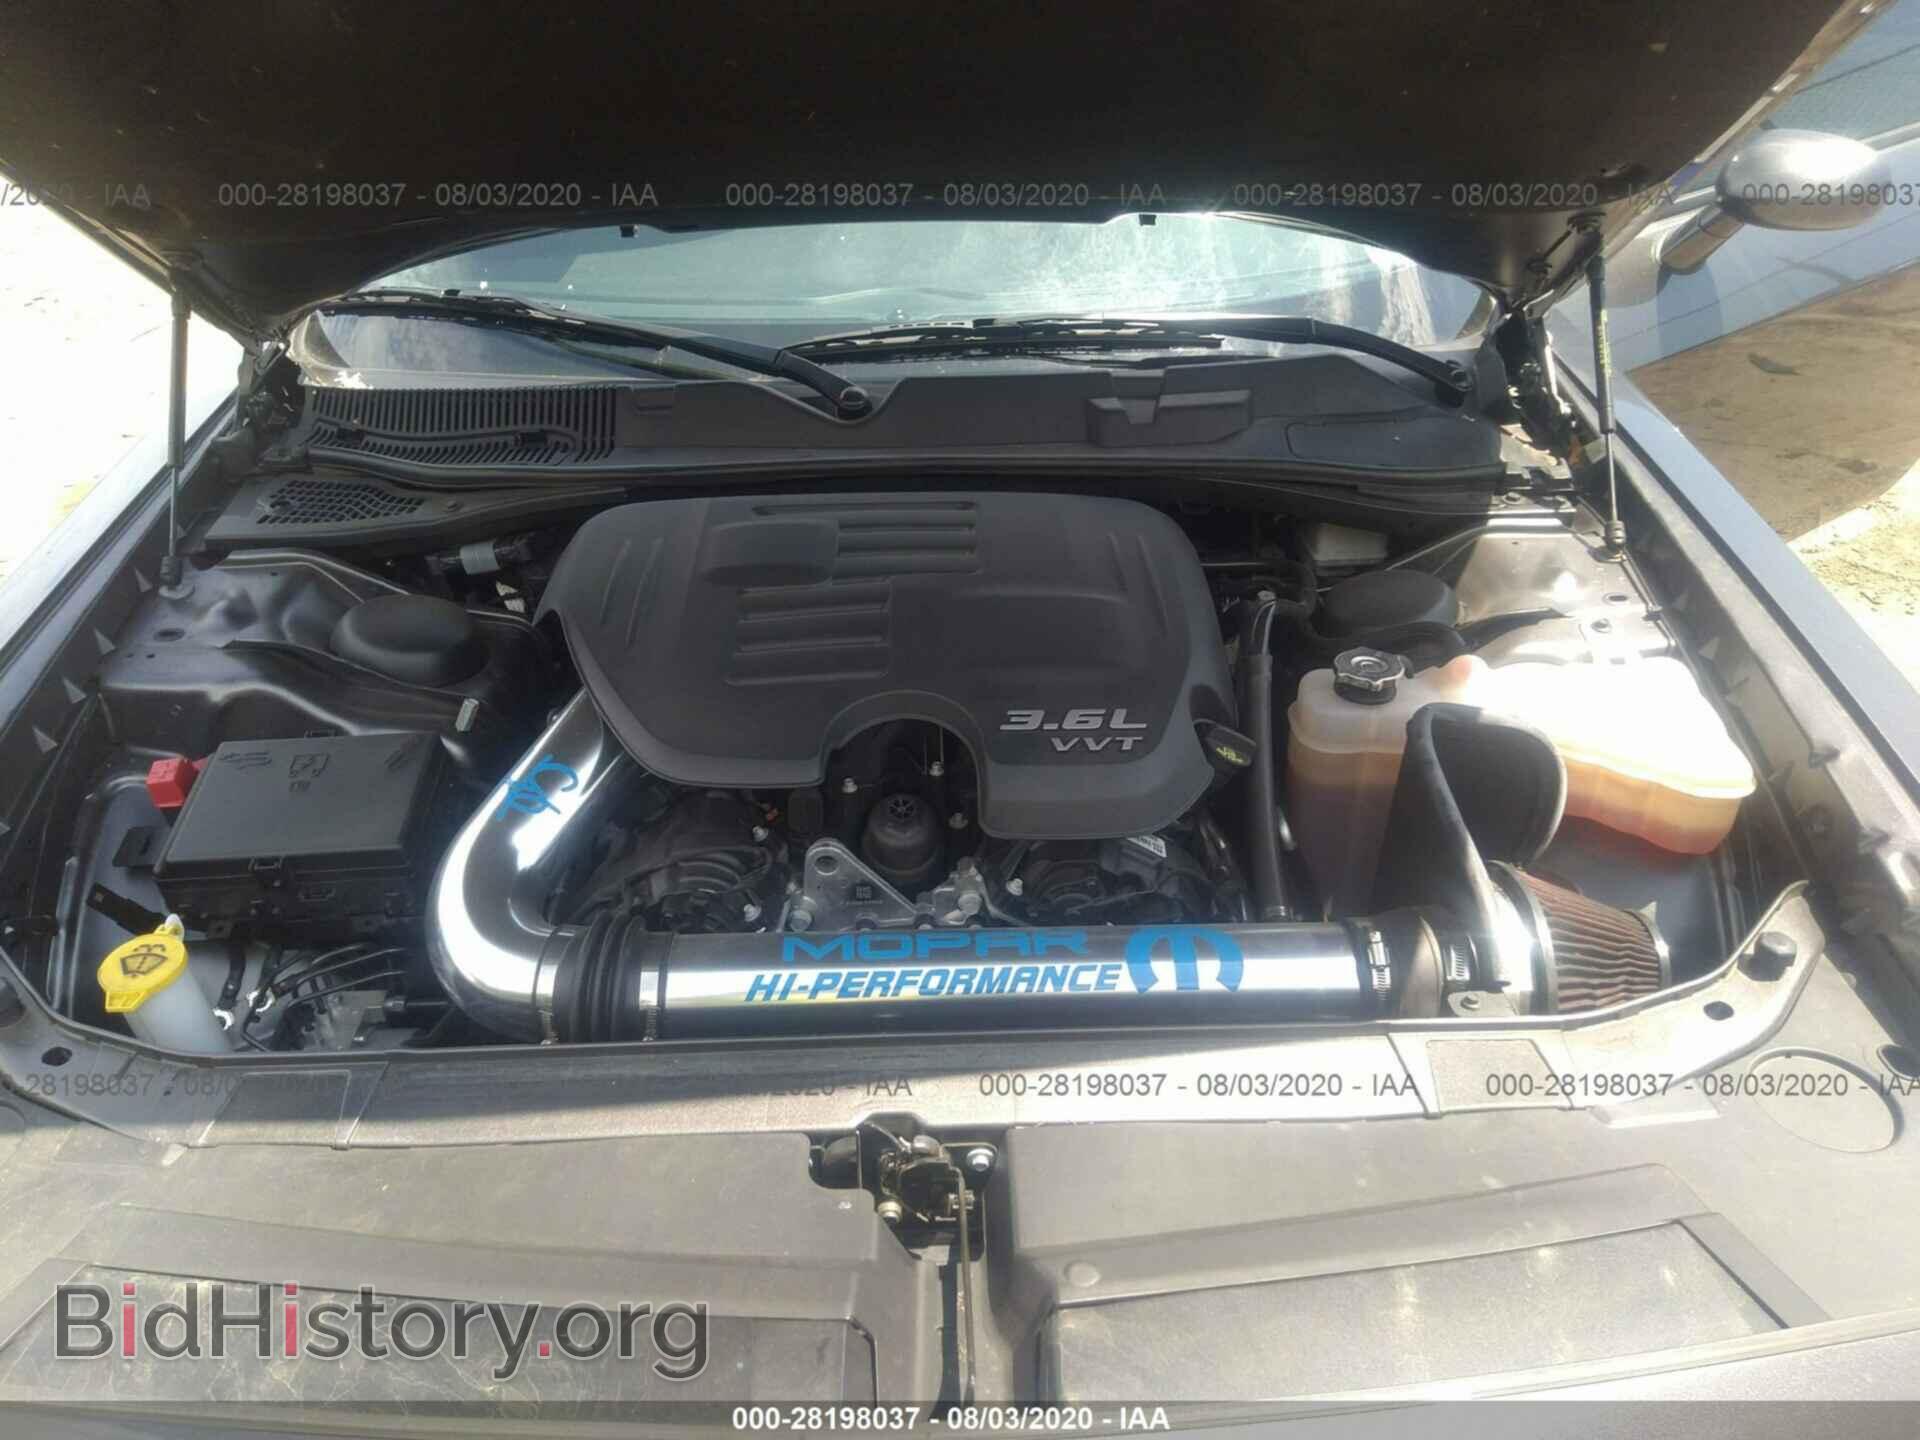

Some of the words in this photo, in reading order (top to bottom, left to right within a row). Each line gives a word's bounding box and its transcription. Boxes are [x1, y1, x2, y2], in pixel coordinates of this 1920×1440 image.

[1000, 708, 1148, 731] 3.6L
[1050, 737, 1144, 752] VVT
[781, 930, 1091, 963] MOPAR
[743, 962, 1122, 1002] HI-PERFORMANCE
